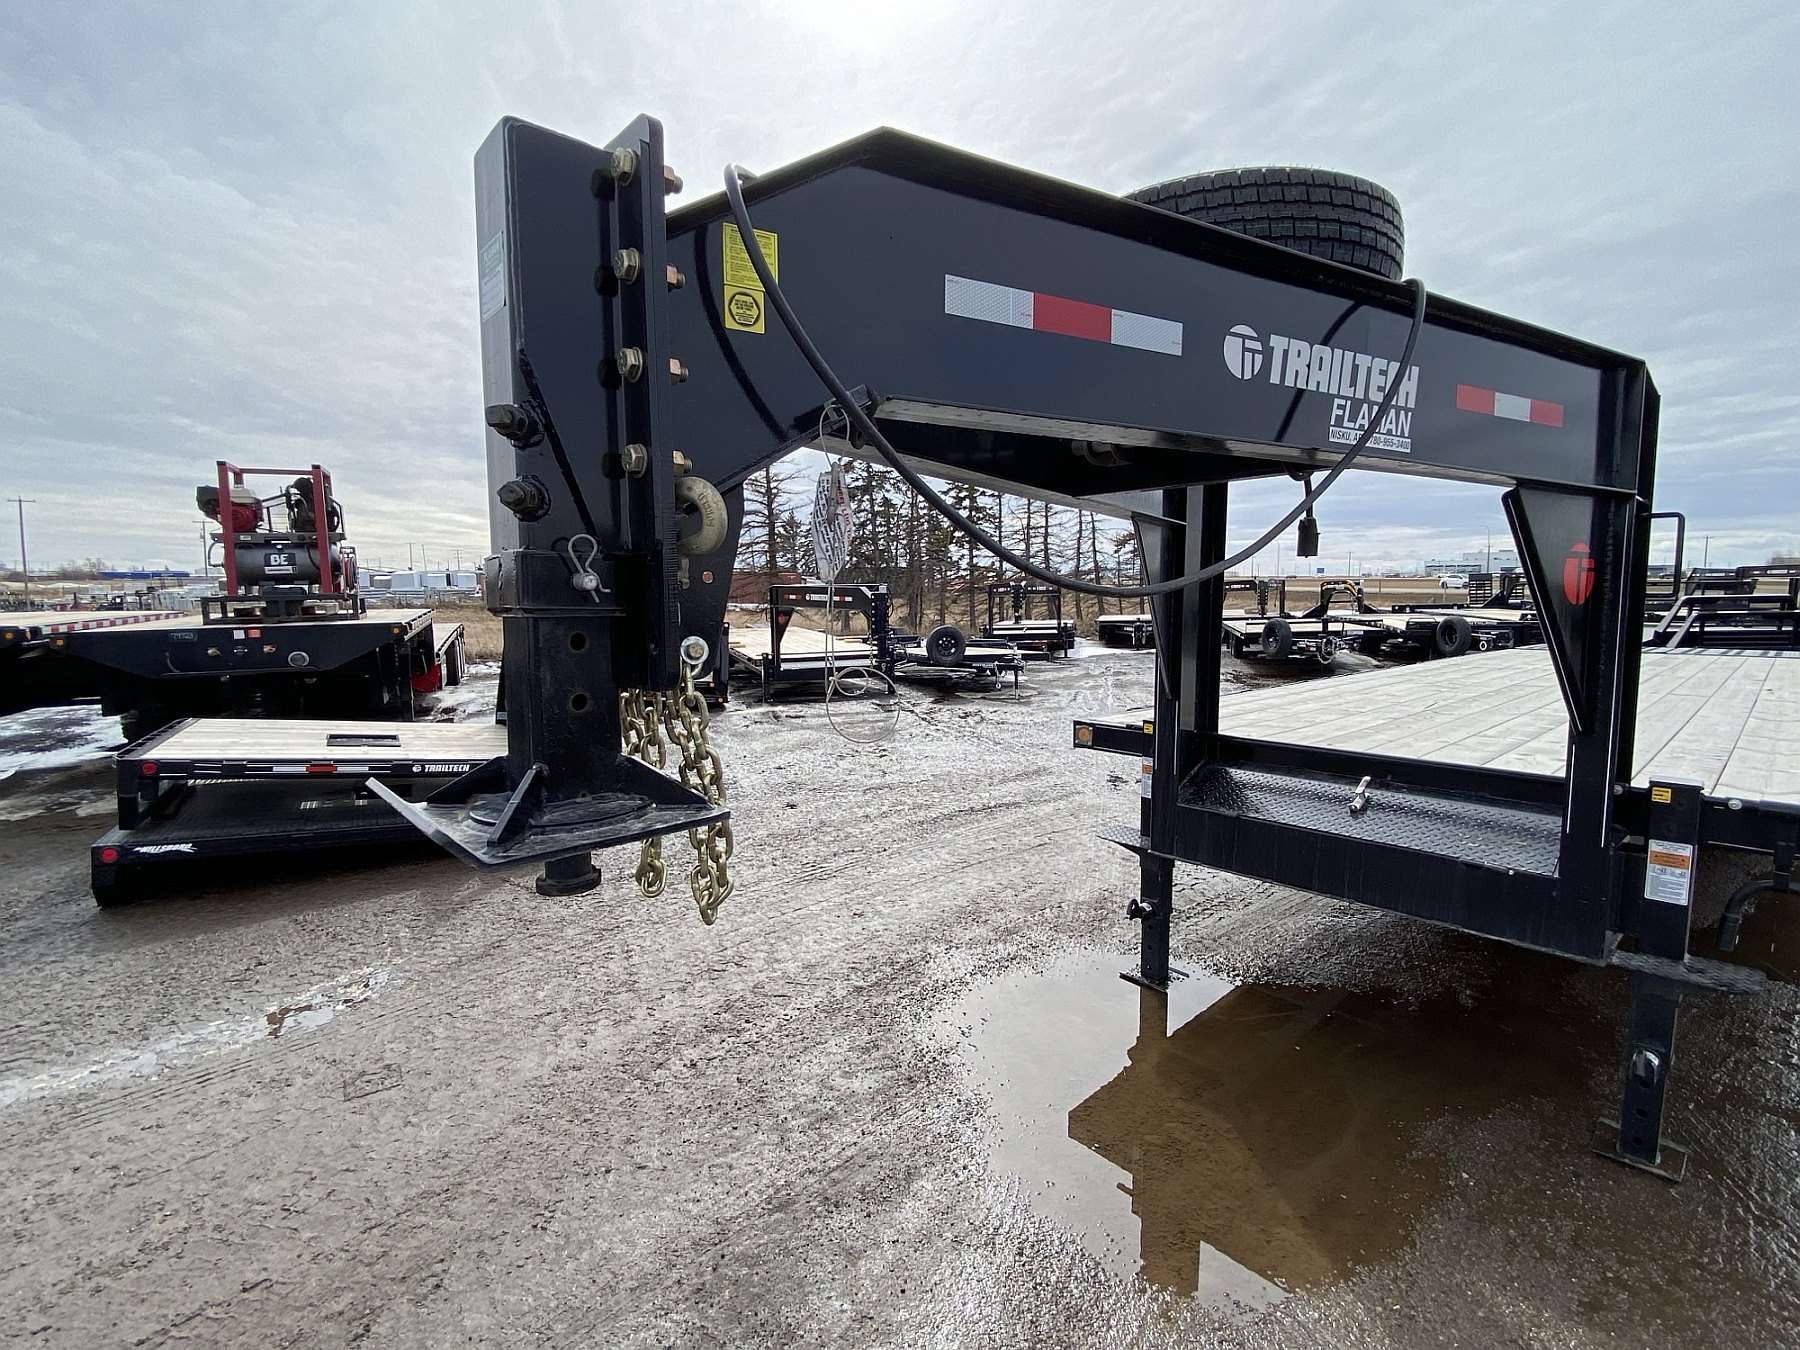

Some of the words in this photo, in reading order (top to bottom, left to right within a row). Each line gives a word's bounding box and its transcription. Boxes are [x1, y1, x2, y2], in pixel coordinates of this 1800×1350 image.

[1269, 334, 1420, 409] TRAILTECH
[270, 554, 289, 566] BE
[424, 764, 470, 773] TRAILTECH
